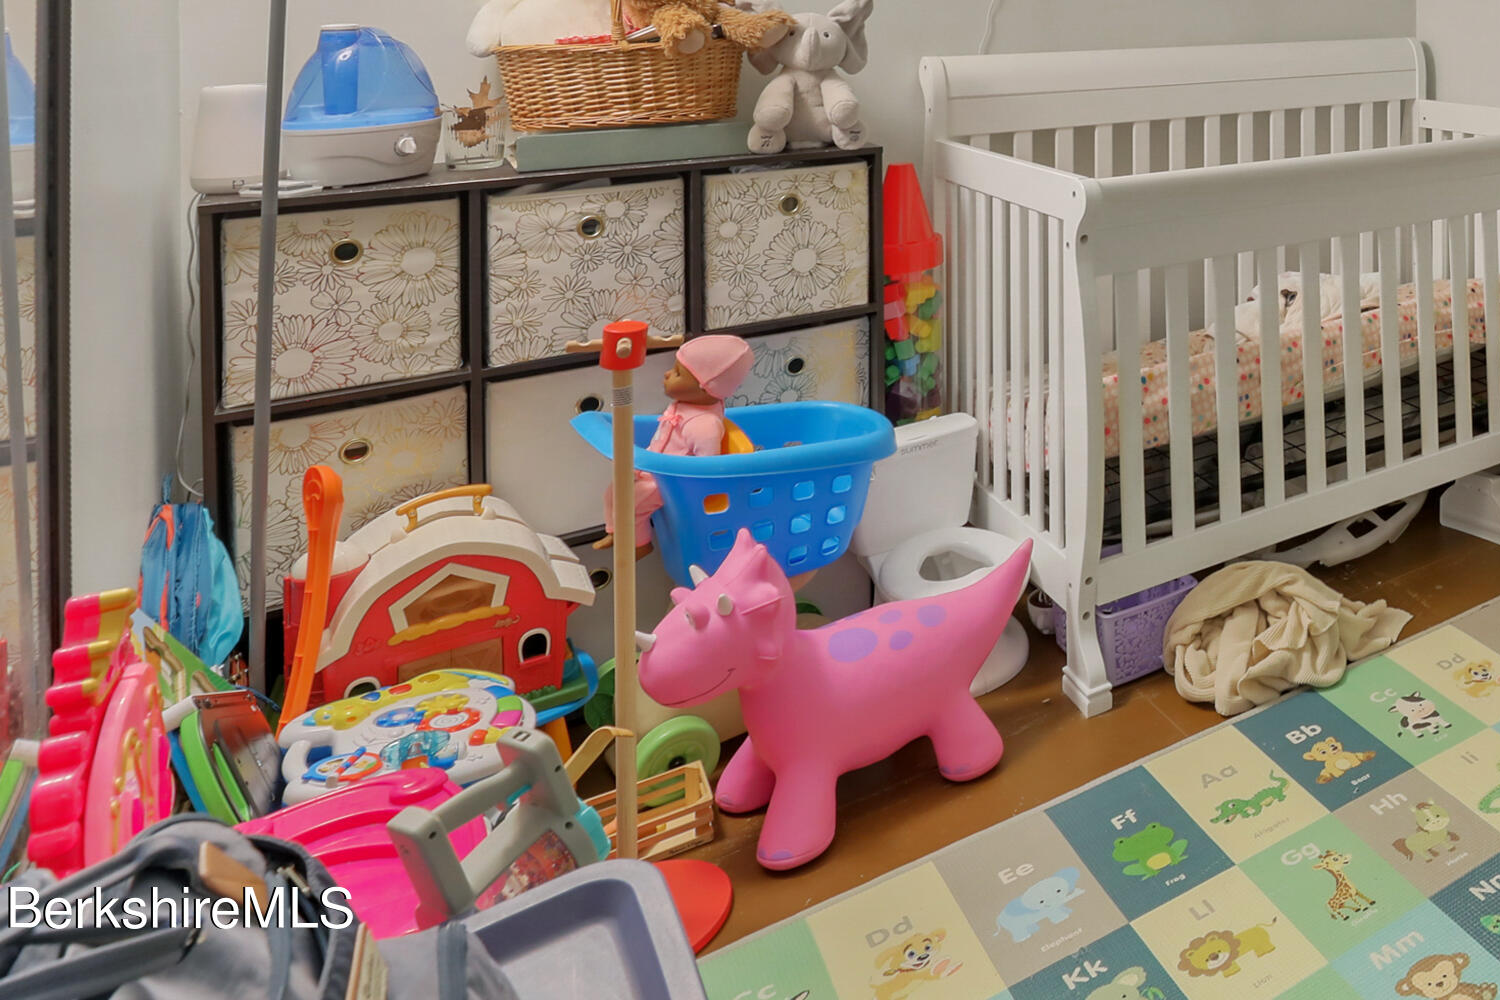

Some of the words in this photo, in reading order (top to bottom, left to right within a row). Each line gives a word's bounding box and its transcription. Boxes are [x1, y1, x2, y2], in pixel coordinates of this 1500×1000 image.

[1436, 653, 1465, 670] Dd
[1369, 688, 1397, 702] Cc
[1285, 724, 1322, 744] Bb
[1200, 764, 1238, 788] Aa
[1369, 792, 1408, 815] Hh
[1110, 808, 1138, 831] Ff
[1281, 842, 1321, 866] Gg
[998, 863, 1035, 885] Ee
[1165, 873, 1186, 887] Frog
[865, 916, 913, 948] Dd
[1369, 930, 1424, 970] Mm
[1062, 960, 1108, 990] Kk
